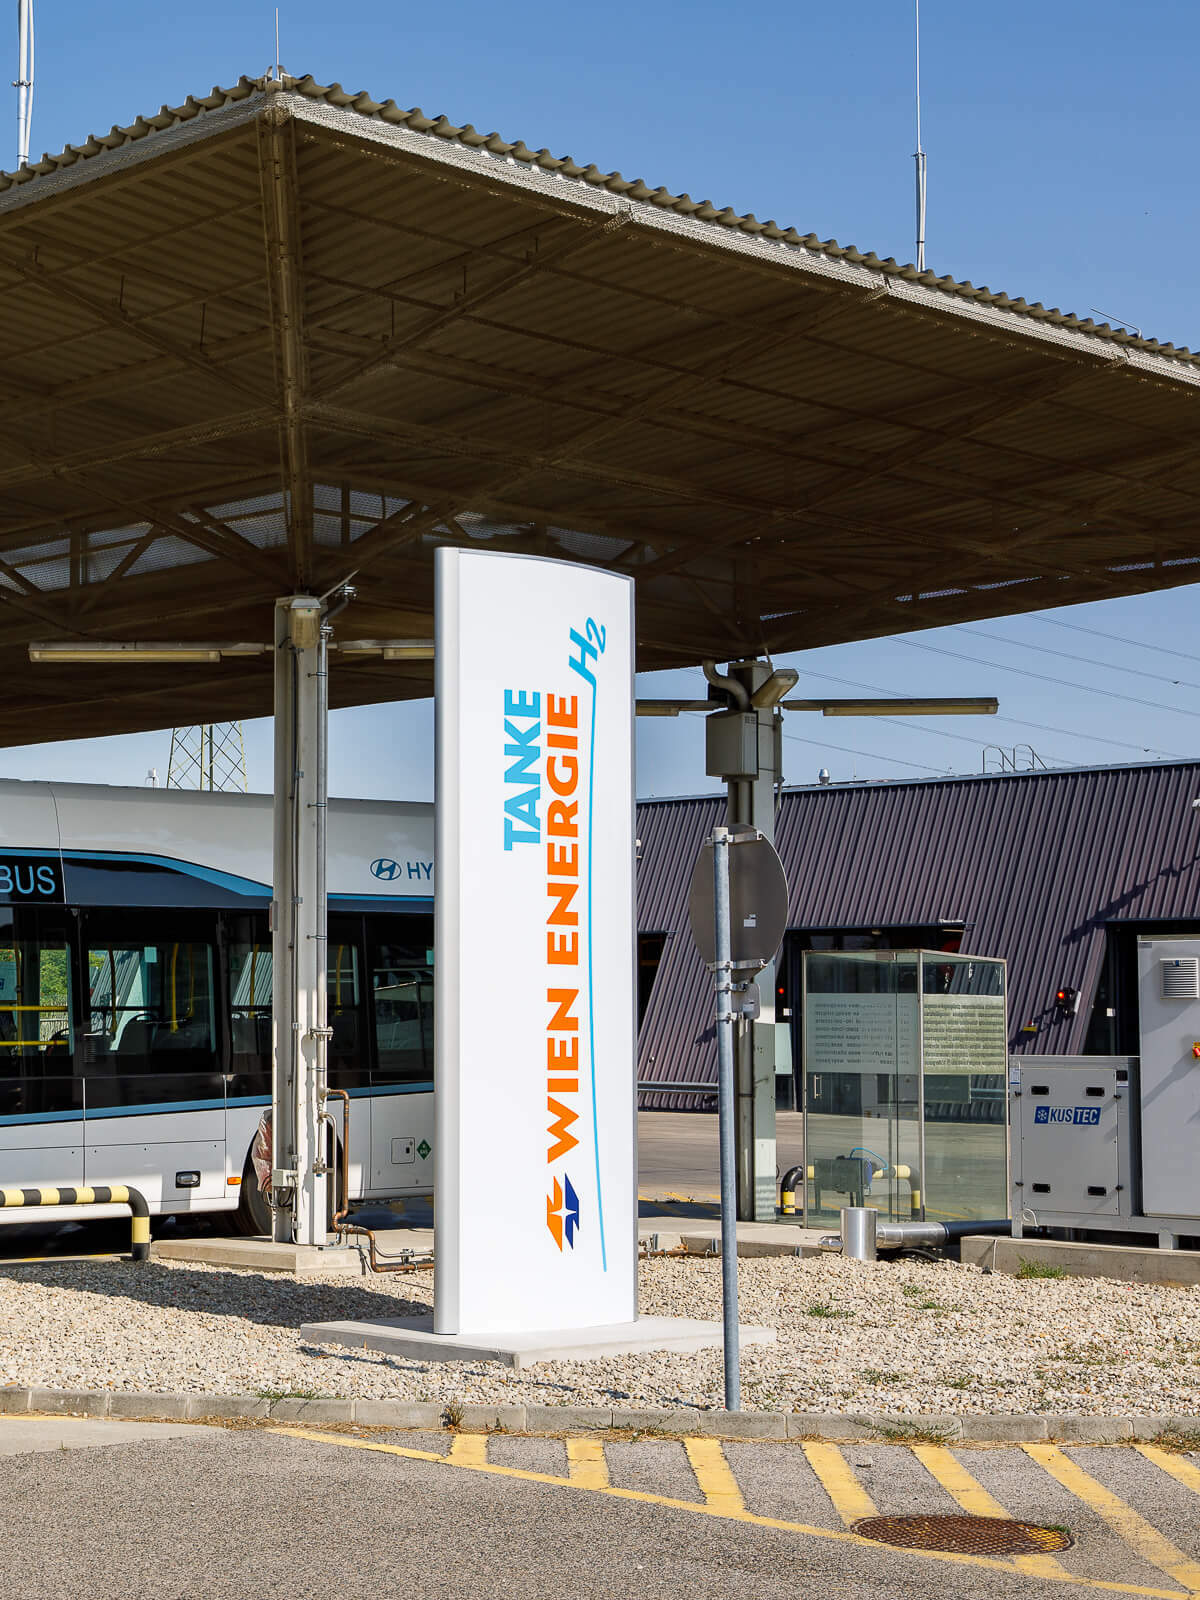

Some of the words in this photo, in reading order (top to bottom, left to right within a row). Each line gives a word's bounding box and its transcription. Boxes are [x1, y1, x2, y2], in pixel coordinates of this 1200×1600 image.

[504, 689, 541, 851] TANKE
[547, 693, 579, 966] ENERGIE
[547, 988, 579, 1164] WIEN
